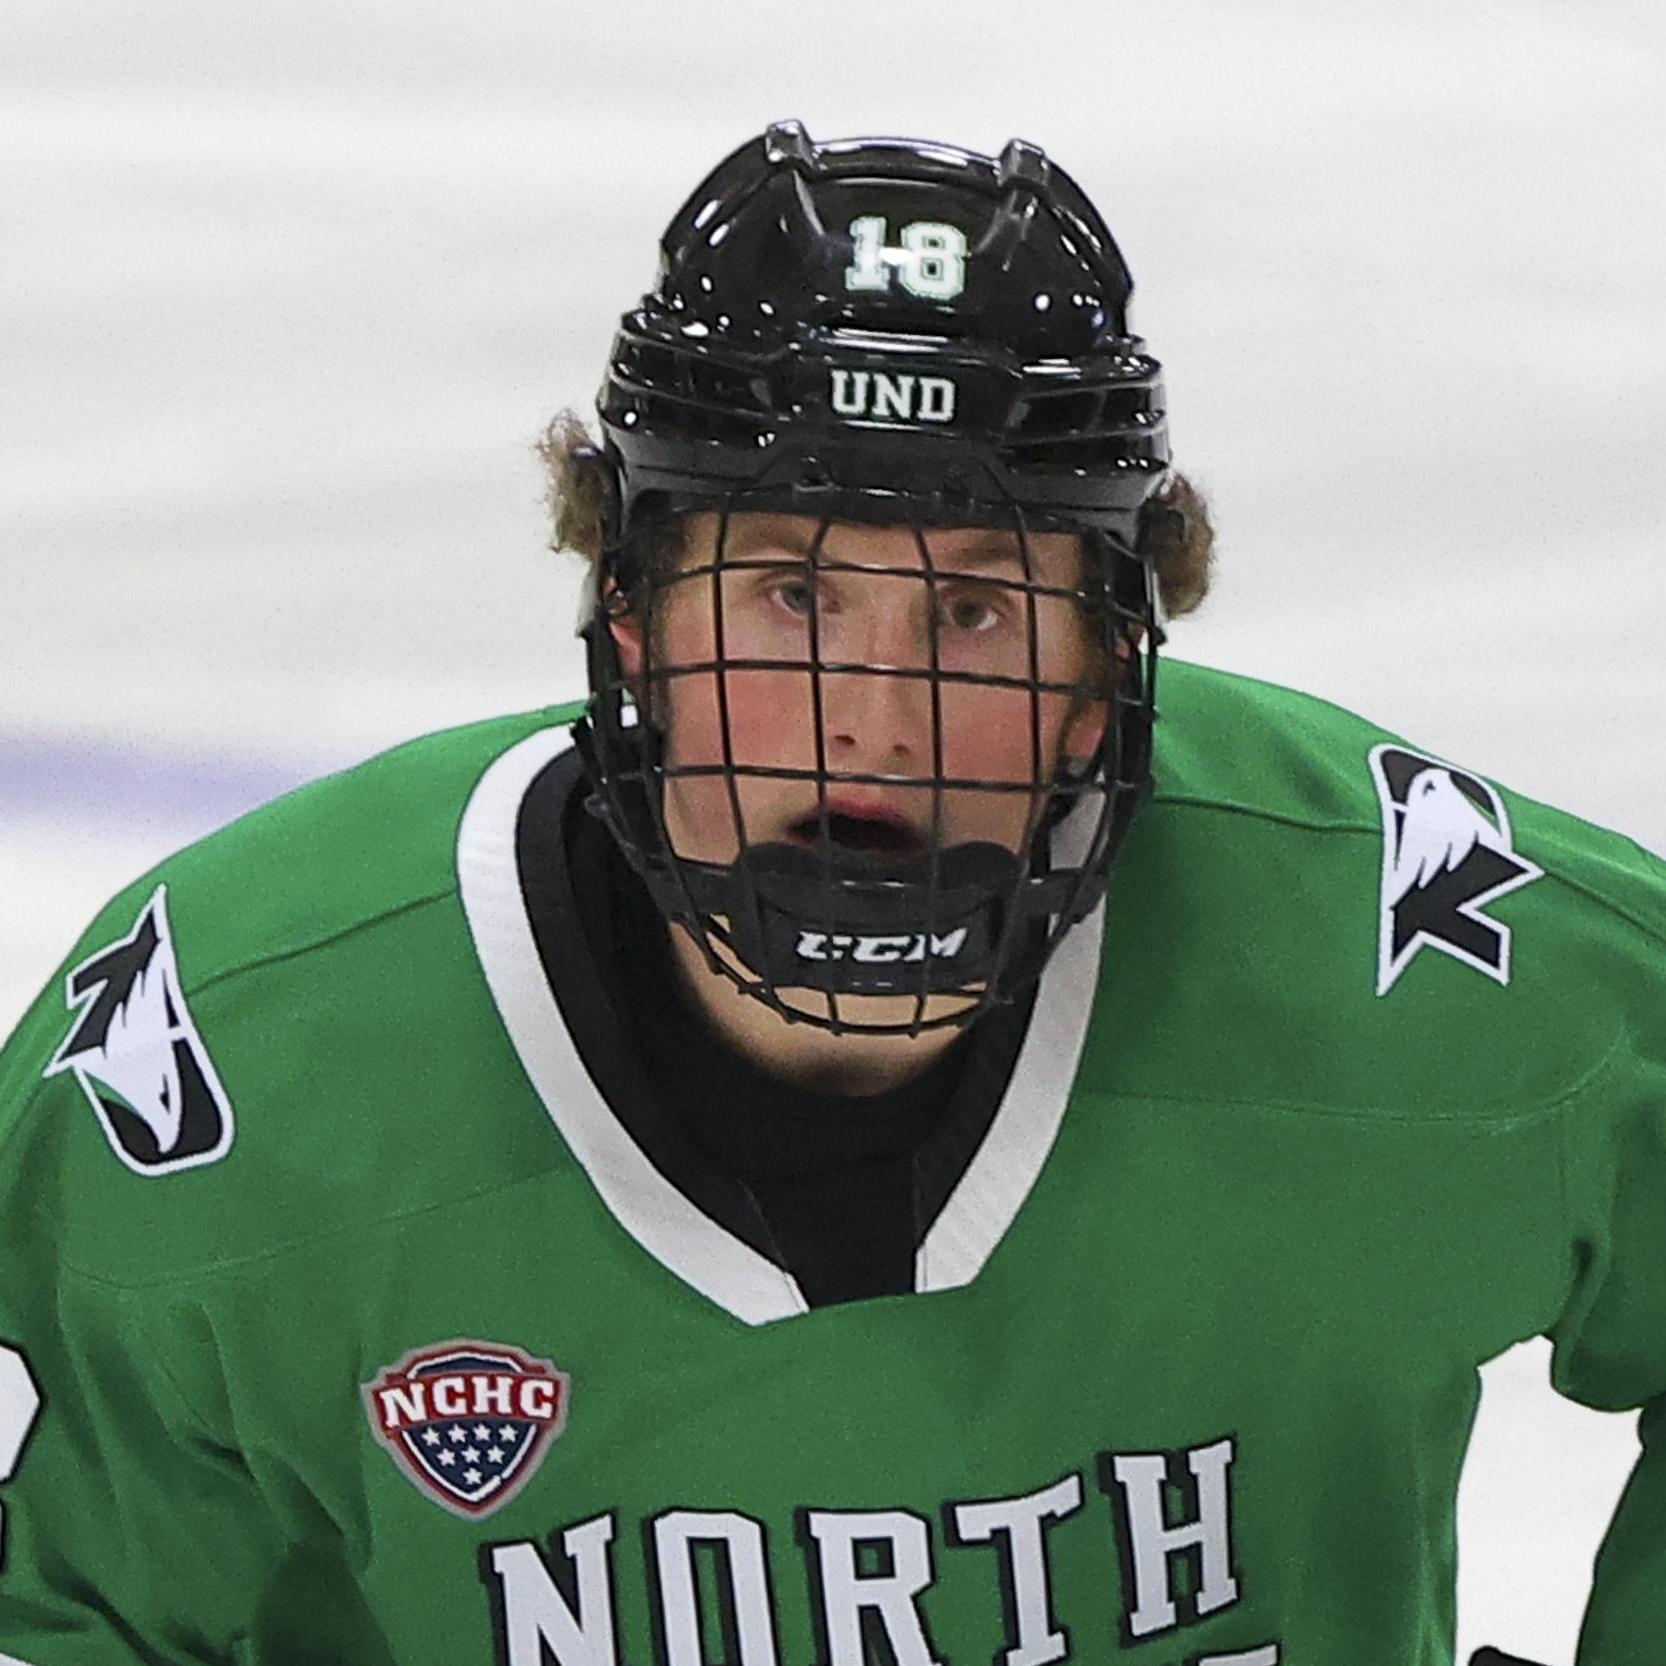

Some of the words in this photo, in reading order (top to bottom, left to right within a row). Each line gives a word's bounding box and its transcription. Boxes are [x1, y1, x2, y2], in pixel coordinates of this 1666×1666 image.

[844, 215, 968, 300] 18
[831, 370, 955, 422] UND
[795, 928, 967, 962] CCM
[379, 1375, 555, 1428] NCHC
